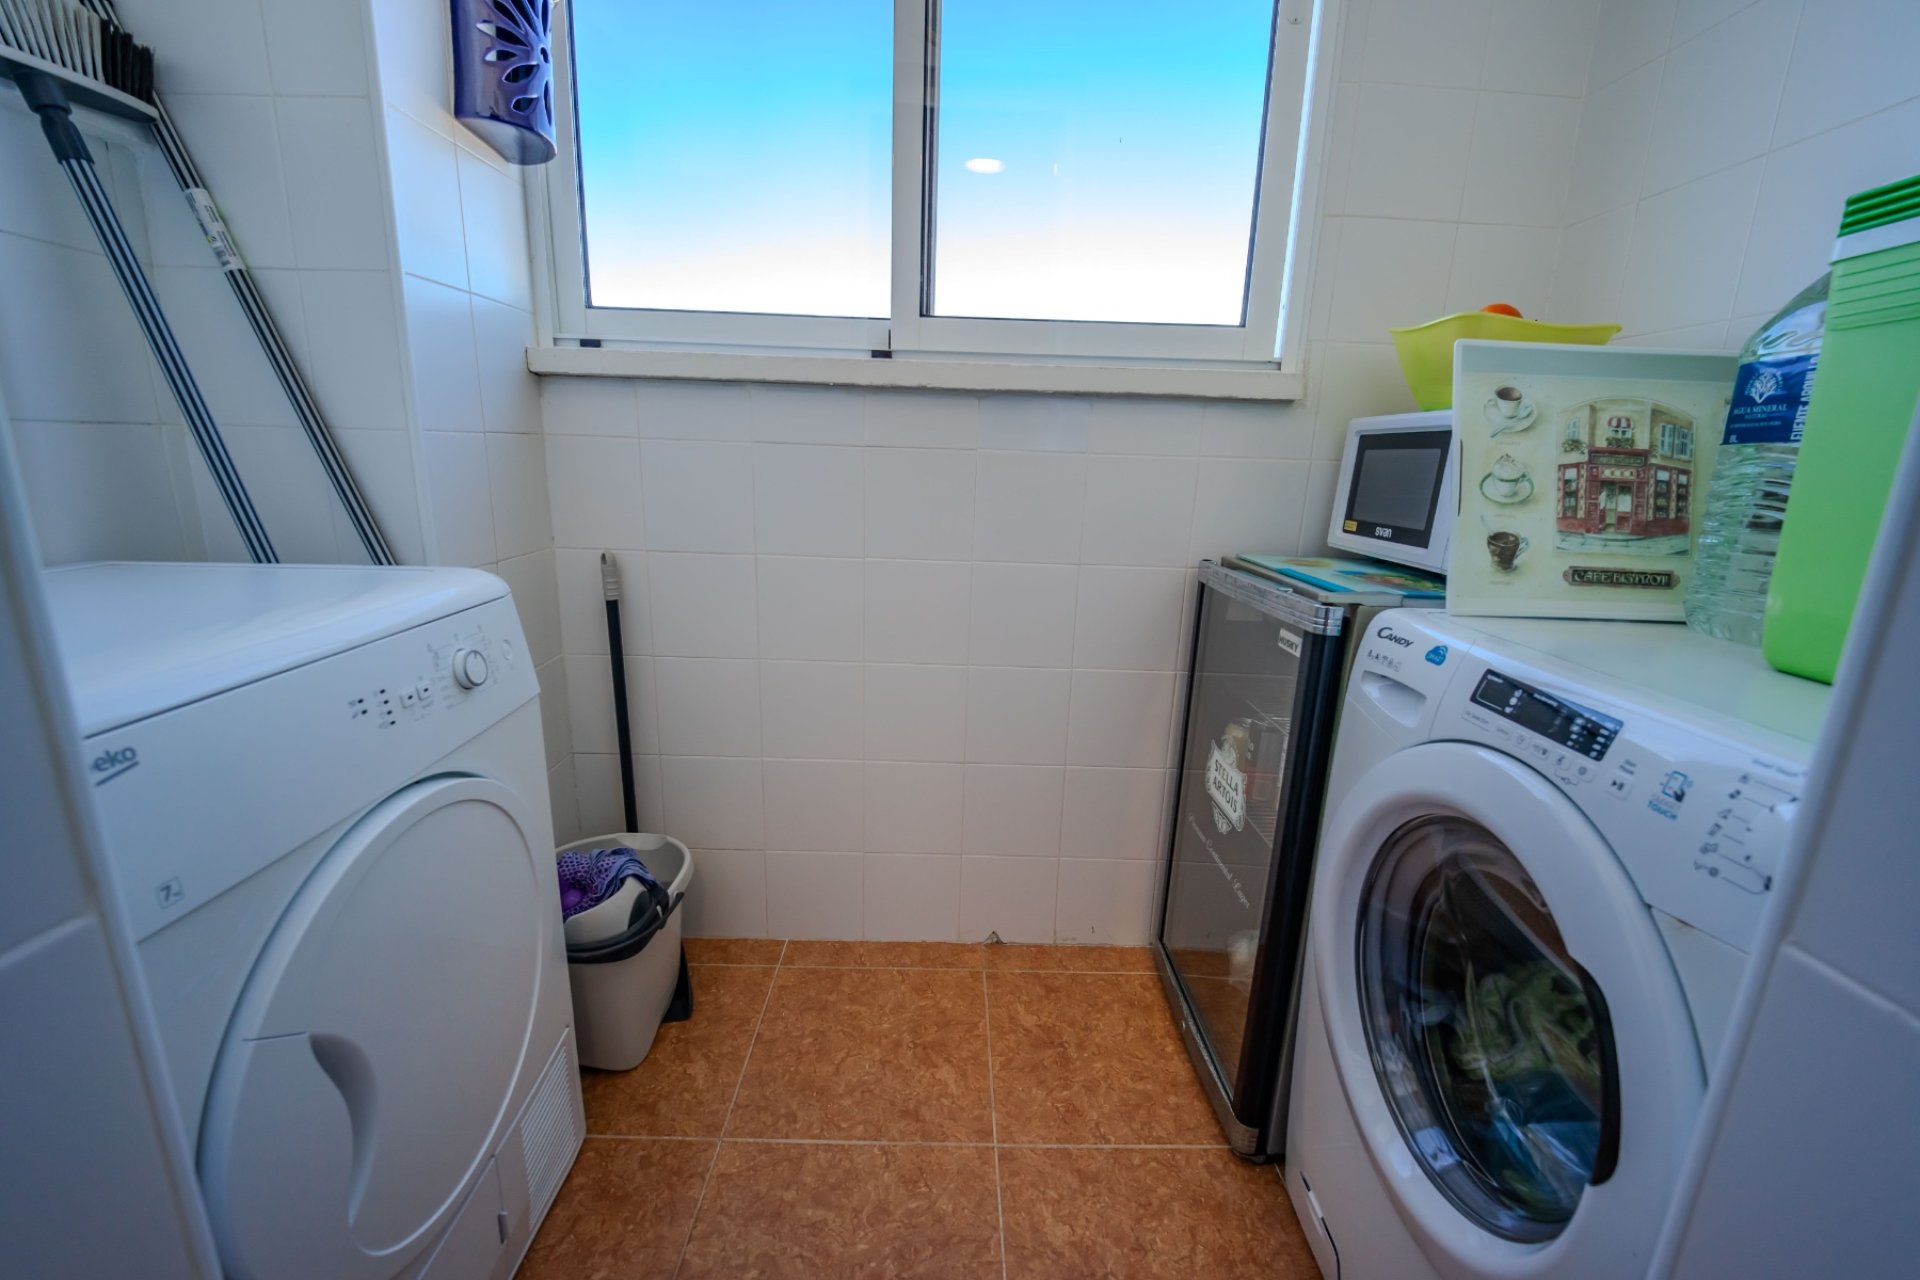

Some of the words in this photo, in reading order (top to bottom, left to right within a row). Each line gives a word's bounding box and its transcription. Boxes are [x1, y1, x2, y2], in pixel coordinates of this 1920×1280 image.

[1753, 403, 1787, 413] MINERAL
[1375, 526, 1392, 538] svan
[1215, 759, 1239, 796] STELLA
[1212, 775, 1237, 813] ARTOIS
